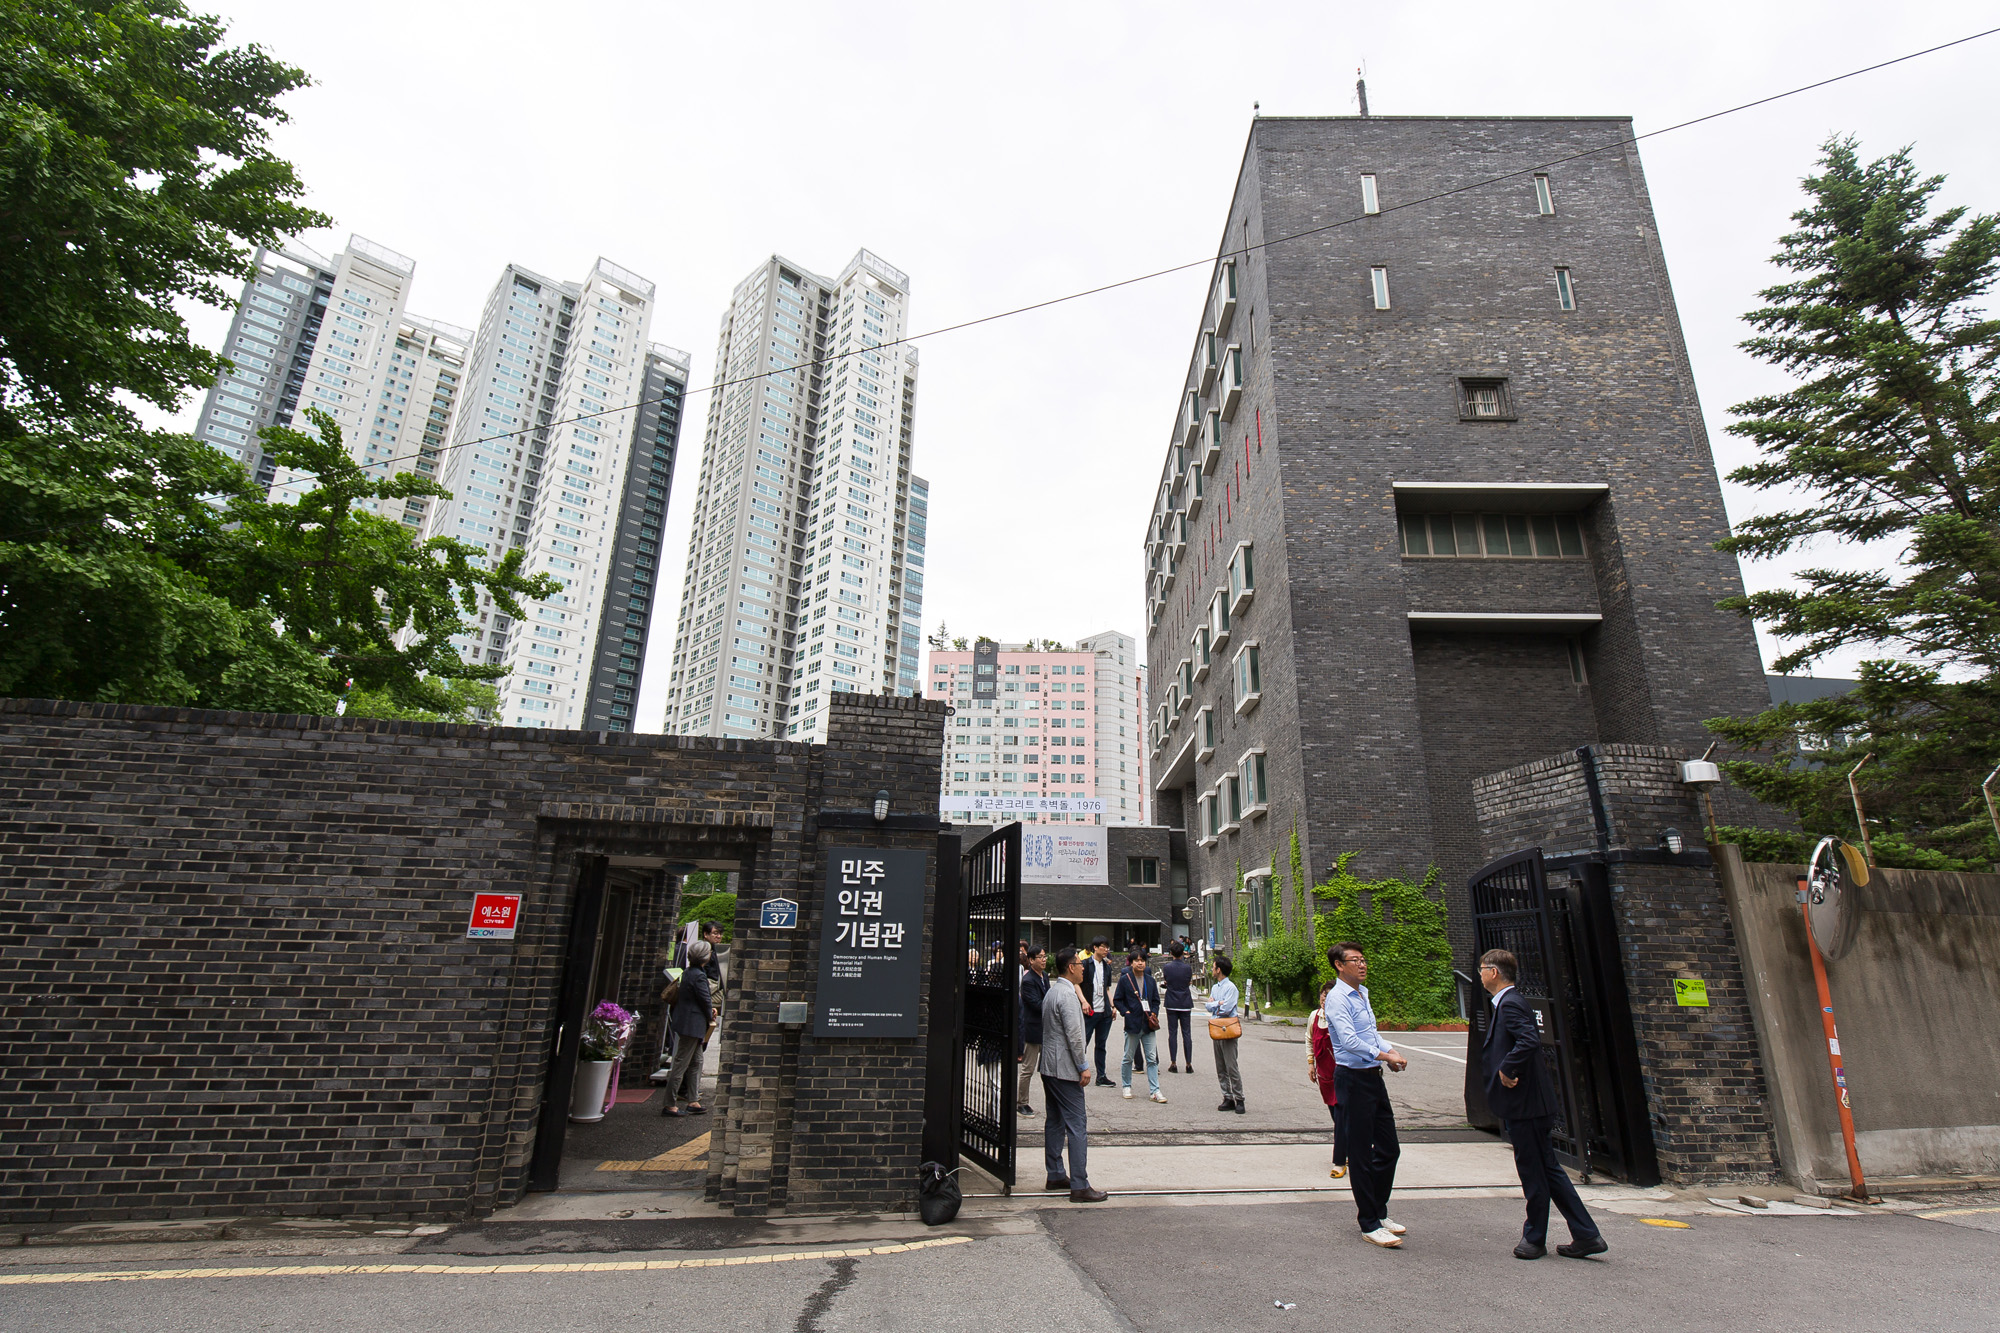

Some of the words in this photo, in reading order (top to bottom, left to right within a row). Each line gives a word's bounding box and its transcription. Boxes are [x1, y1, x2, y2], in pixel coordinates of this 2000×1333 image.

[974, 799, 1035, 810] 철근콘크리트
[1039, 799, 1073, 811] 흑벽돌,
[1077, 801, 1101, 811] 1976
[1083, 857, 1099, 866] 1987
[841, 859, 885, 885] 민주
[838, 890, 883, 916] 인권
[482, 906, 511, 918] 에스원
[769, 913, 789, 925] 37
[835, 922, 905, 948] 기념관
